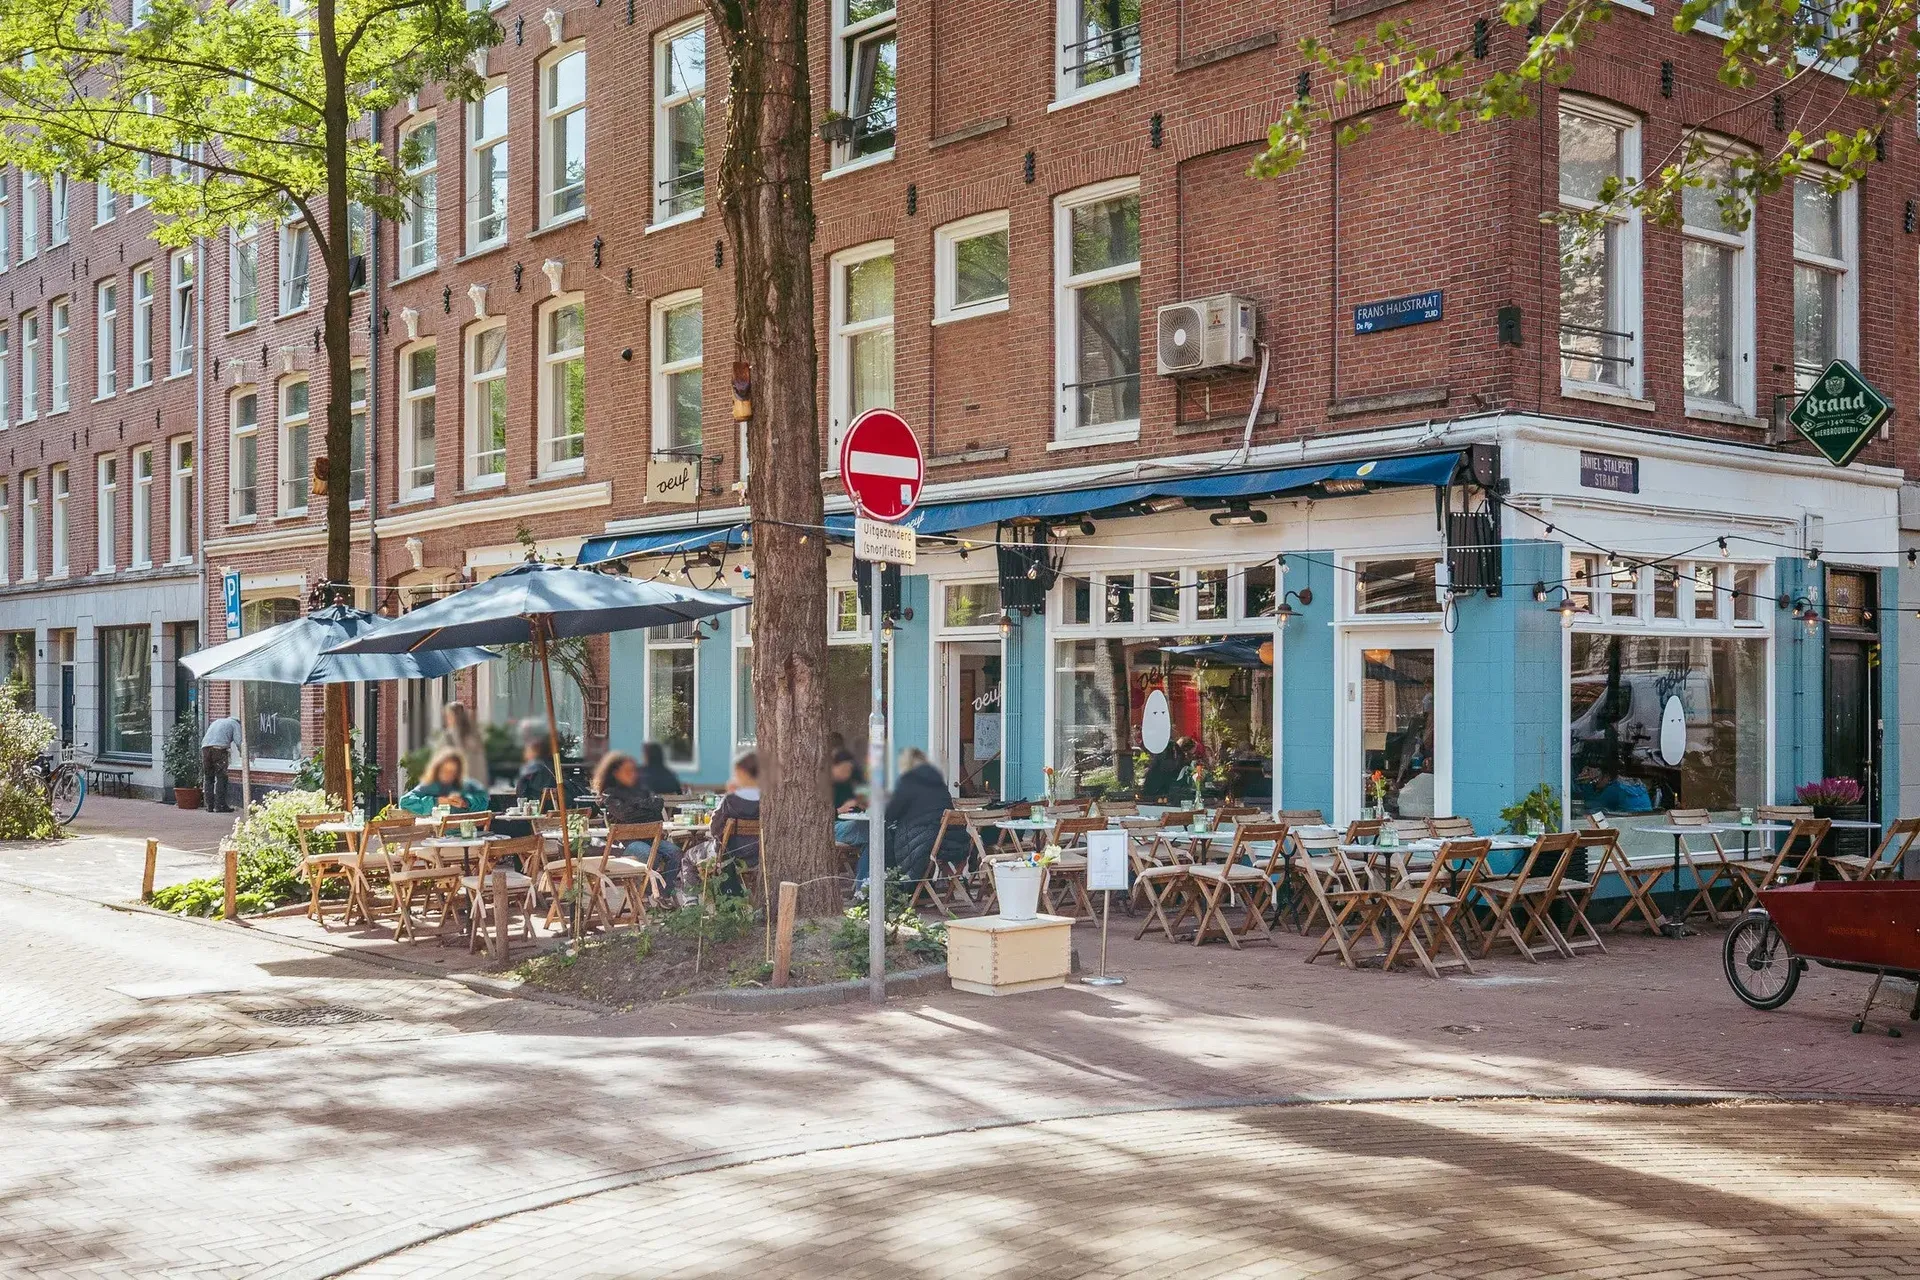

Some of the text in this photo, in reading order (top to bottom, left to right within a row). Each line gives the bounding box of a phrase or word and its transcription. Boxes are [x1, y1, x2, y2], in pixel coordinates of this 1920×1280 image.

[1357, 294, 1438, 320] FRANS HALSSTRAAT
[1424, 309, 1439, 319] ZUID
[1806, 391, 1866, 417] Brand
[1603, 459, 1633, 475] STALPERT
[656, 467, 690, 494] oeuf
[1594, 473, 1619, 488] STRAAT
[863, 523, 912, 542] Uitgezonderd
[863, 541, 912, 560] (snor)fietsers
[226, 578, 236, 607] P
[259, 711, 278, 735] NAT
